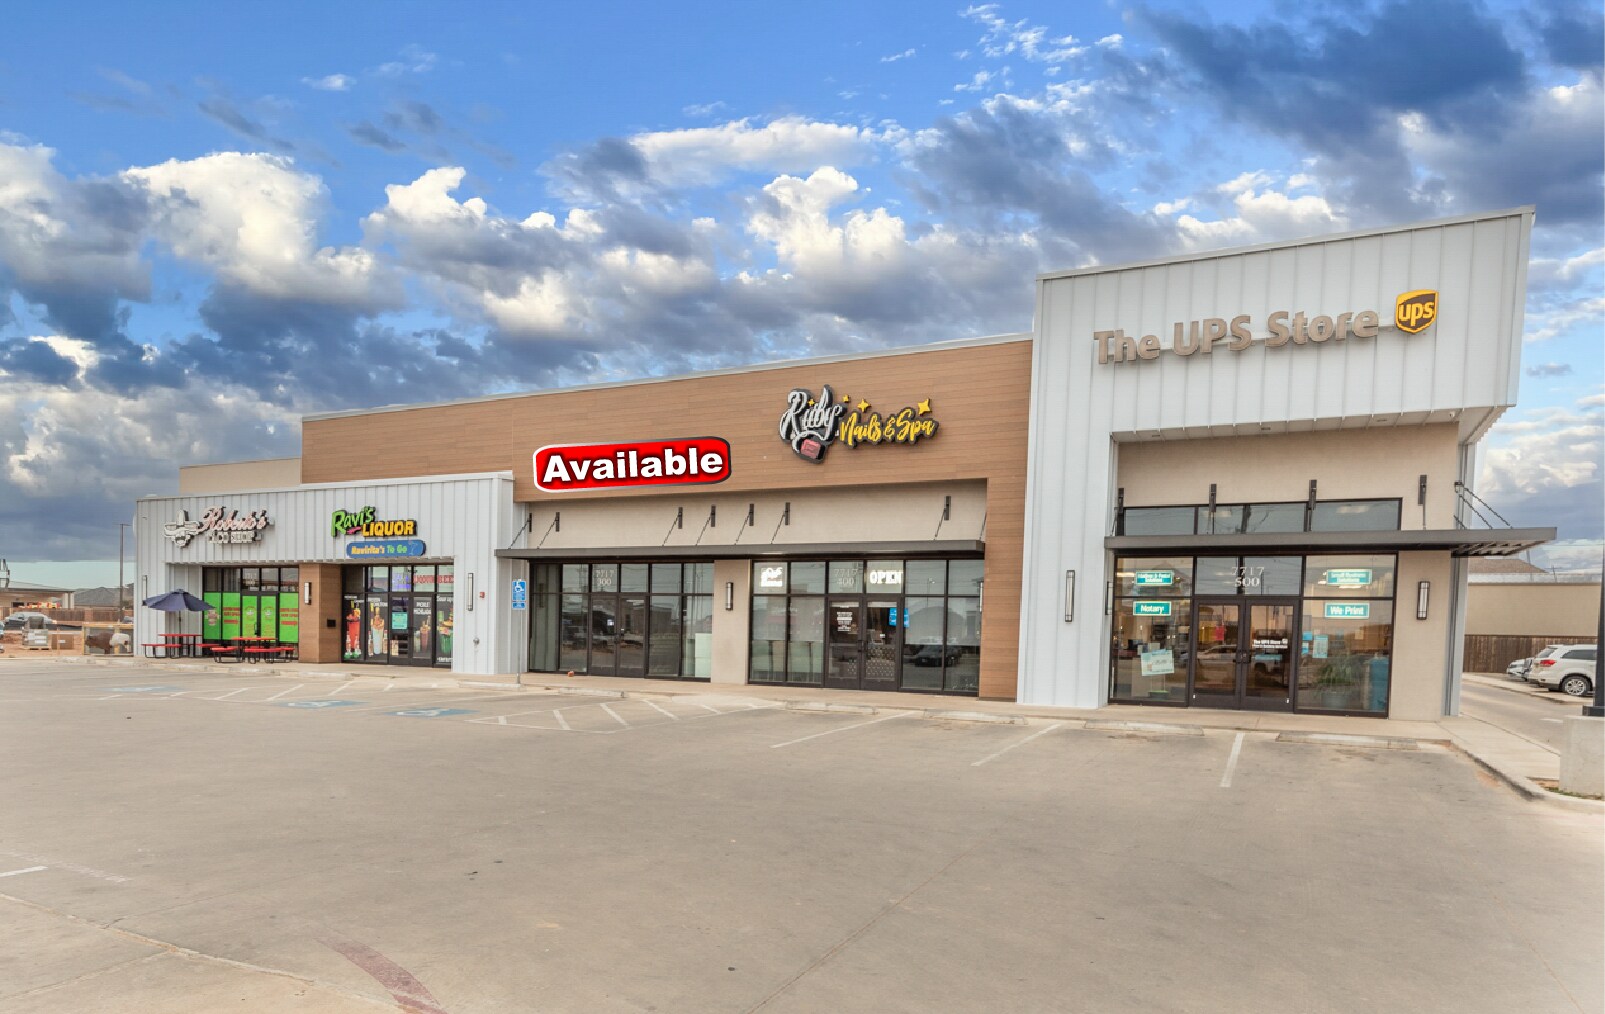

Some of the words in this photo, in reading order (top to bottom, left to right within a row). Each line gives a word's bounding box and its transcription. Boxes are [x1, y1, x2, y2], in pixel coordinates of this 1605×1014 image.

[1398, 301, 1435, 327] ups
[1093, 328, 1161, 365] The
[1173, 314, 1253, 357] UPS
[1264, 310, 1380, 348] Store
[779, 385, 843, 446] Ruby
[839, 411, 882, 446] Nails
[884, 416, 896, 440] &
[896, 408, 936, 442] Spa
[331, 506, 376, 537] Ravi's
[362, 520, 415, 537] LIQUOR
[387, 544, 395, 554] To
[397, 544, 408, 554] Go
[870, 570, 903, 585] OPEN
[1231, 566, 1265, 577] 7717
[1234, 576, 1260, 588] 500
[1140, 604, 1165, 615] Notary
[1330, 606, 1343, 615] We
[1344, 606, 1364, 615] Print
